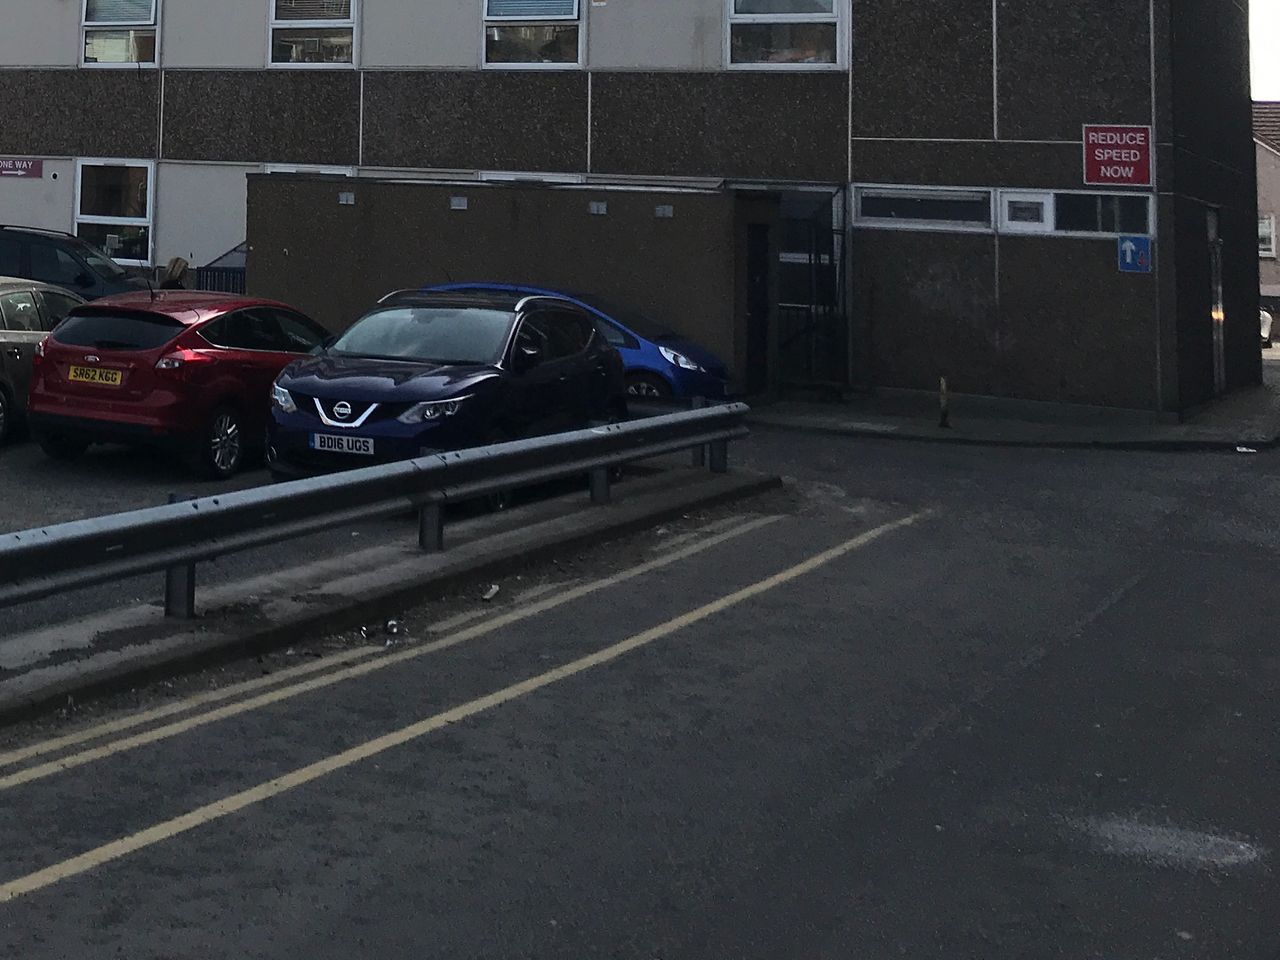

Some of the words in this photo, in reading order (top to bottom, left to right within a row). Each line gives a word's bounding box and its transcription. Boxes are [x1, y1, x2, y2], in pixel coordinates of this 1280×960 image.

[1088, 132, 1146, 145] REDUCE
[1094, 148, 1140, 162] SPEED
[14, 160, 33, 169] WAY
[1100, 165, 1135, 178] NOW
[319, 435, 344, 451] BD16
[346, 438, 370, 453] UGS
